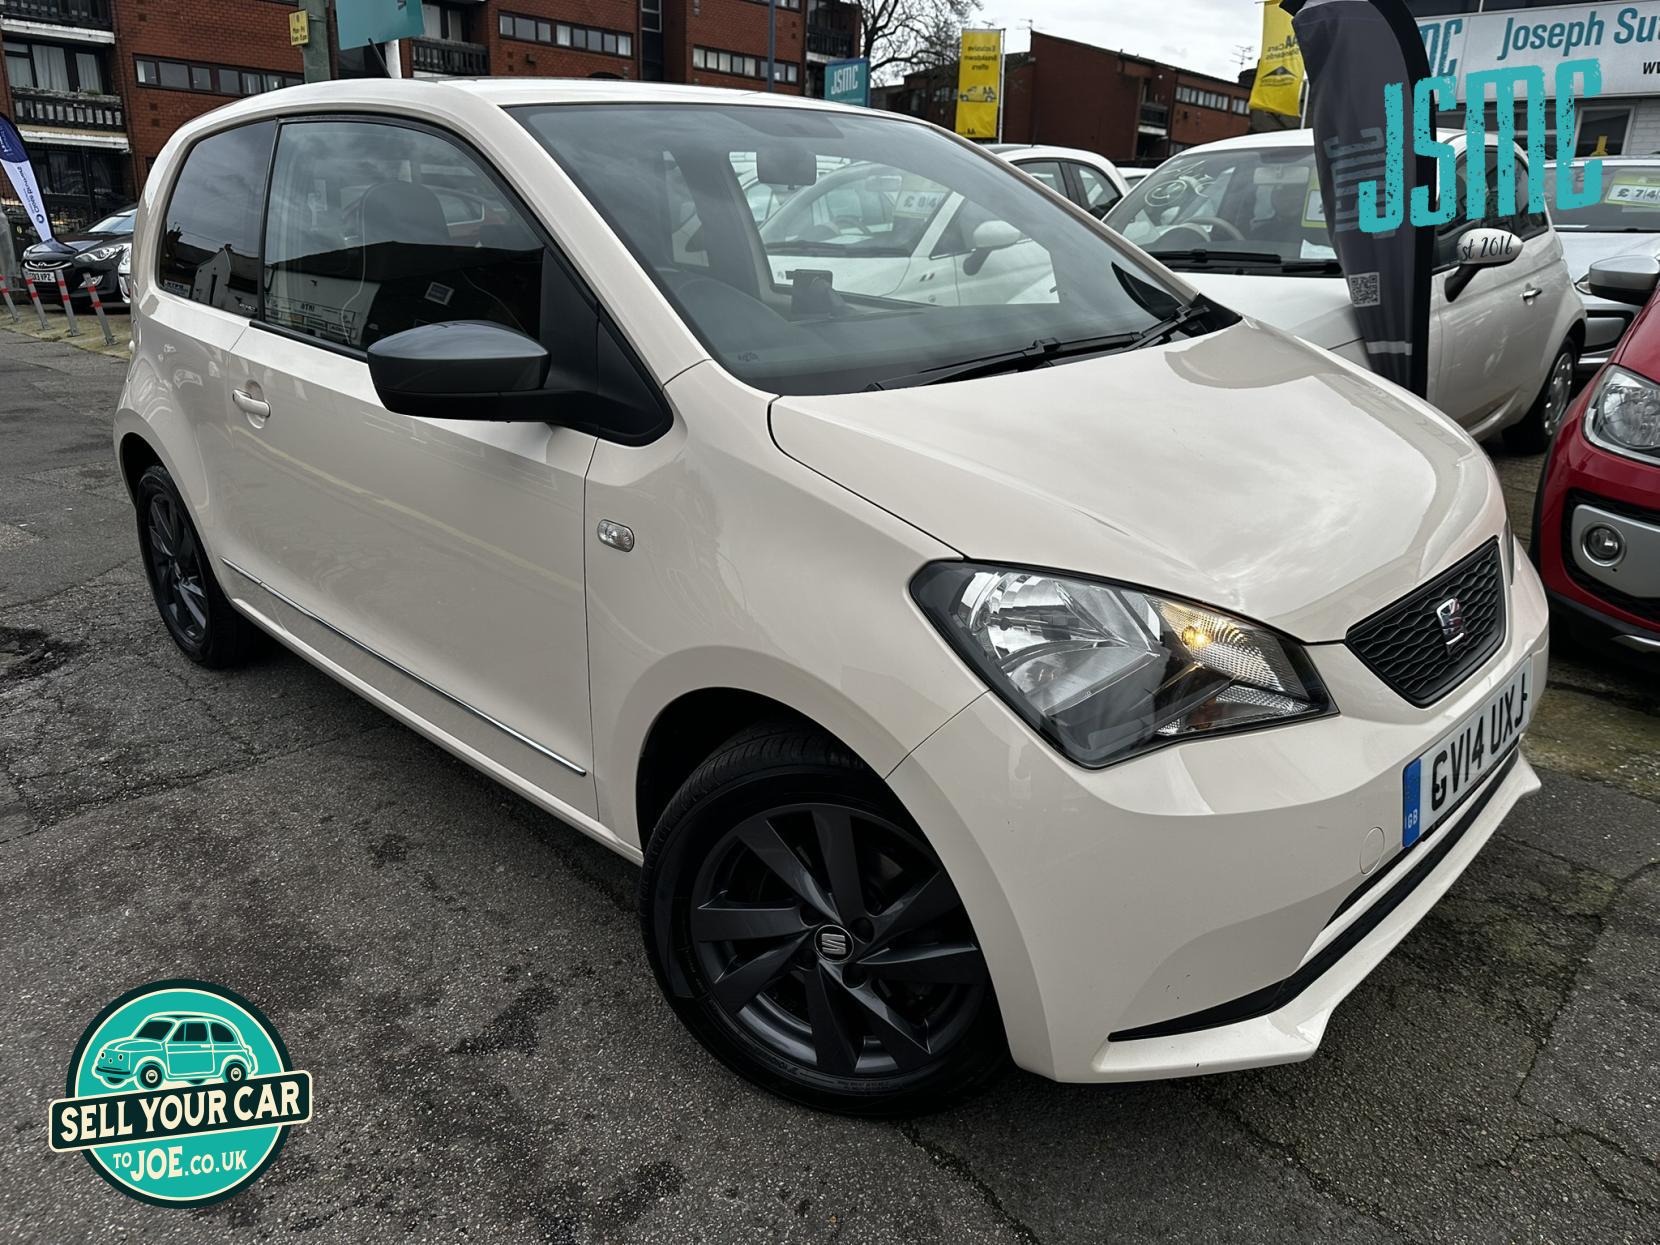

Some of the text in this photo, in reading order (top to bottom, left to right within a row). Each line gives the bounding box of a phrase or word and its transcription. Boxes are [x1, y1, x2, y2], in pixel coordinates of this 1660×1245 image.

[1497, 7, 1660, 60] Joseph Su
[831, 65, 859, 95] JSMC
[1481, 234, 1512, 258] 2016
[1432, 672, 1528, 812] GV14 UXJ
[1407, 808, 1418, 829] GB
